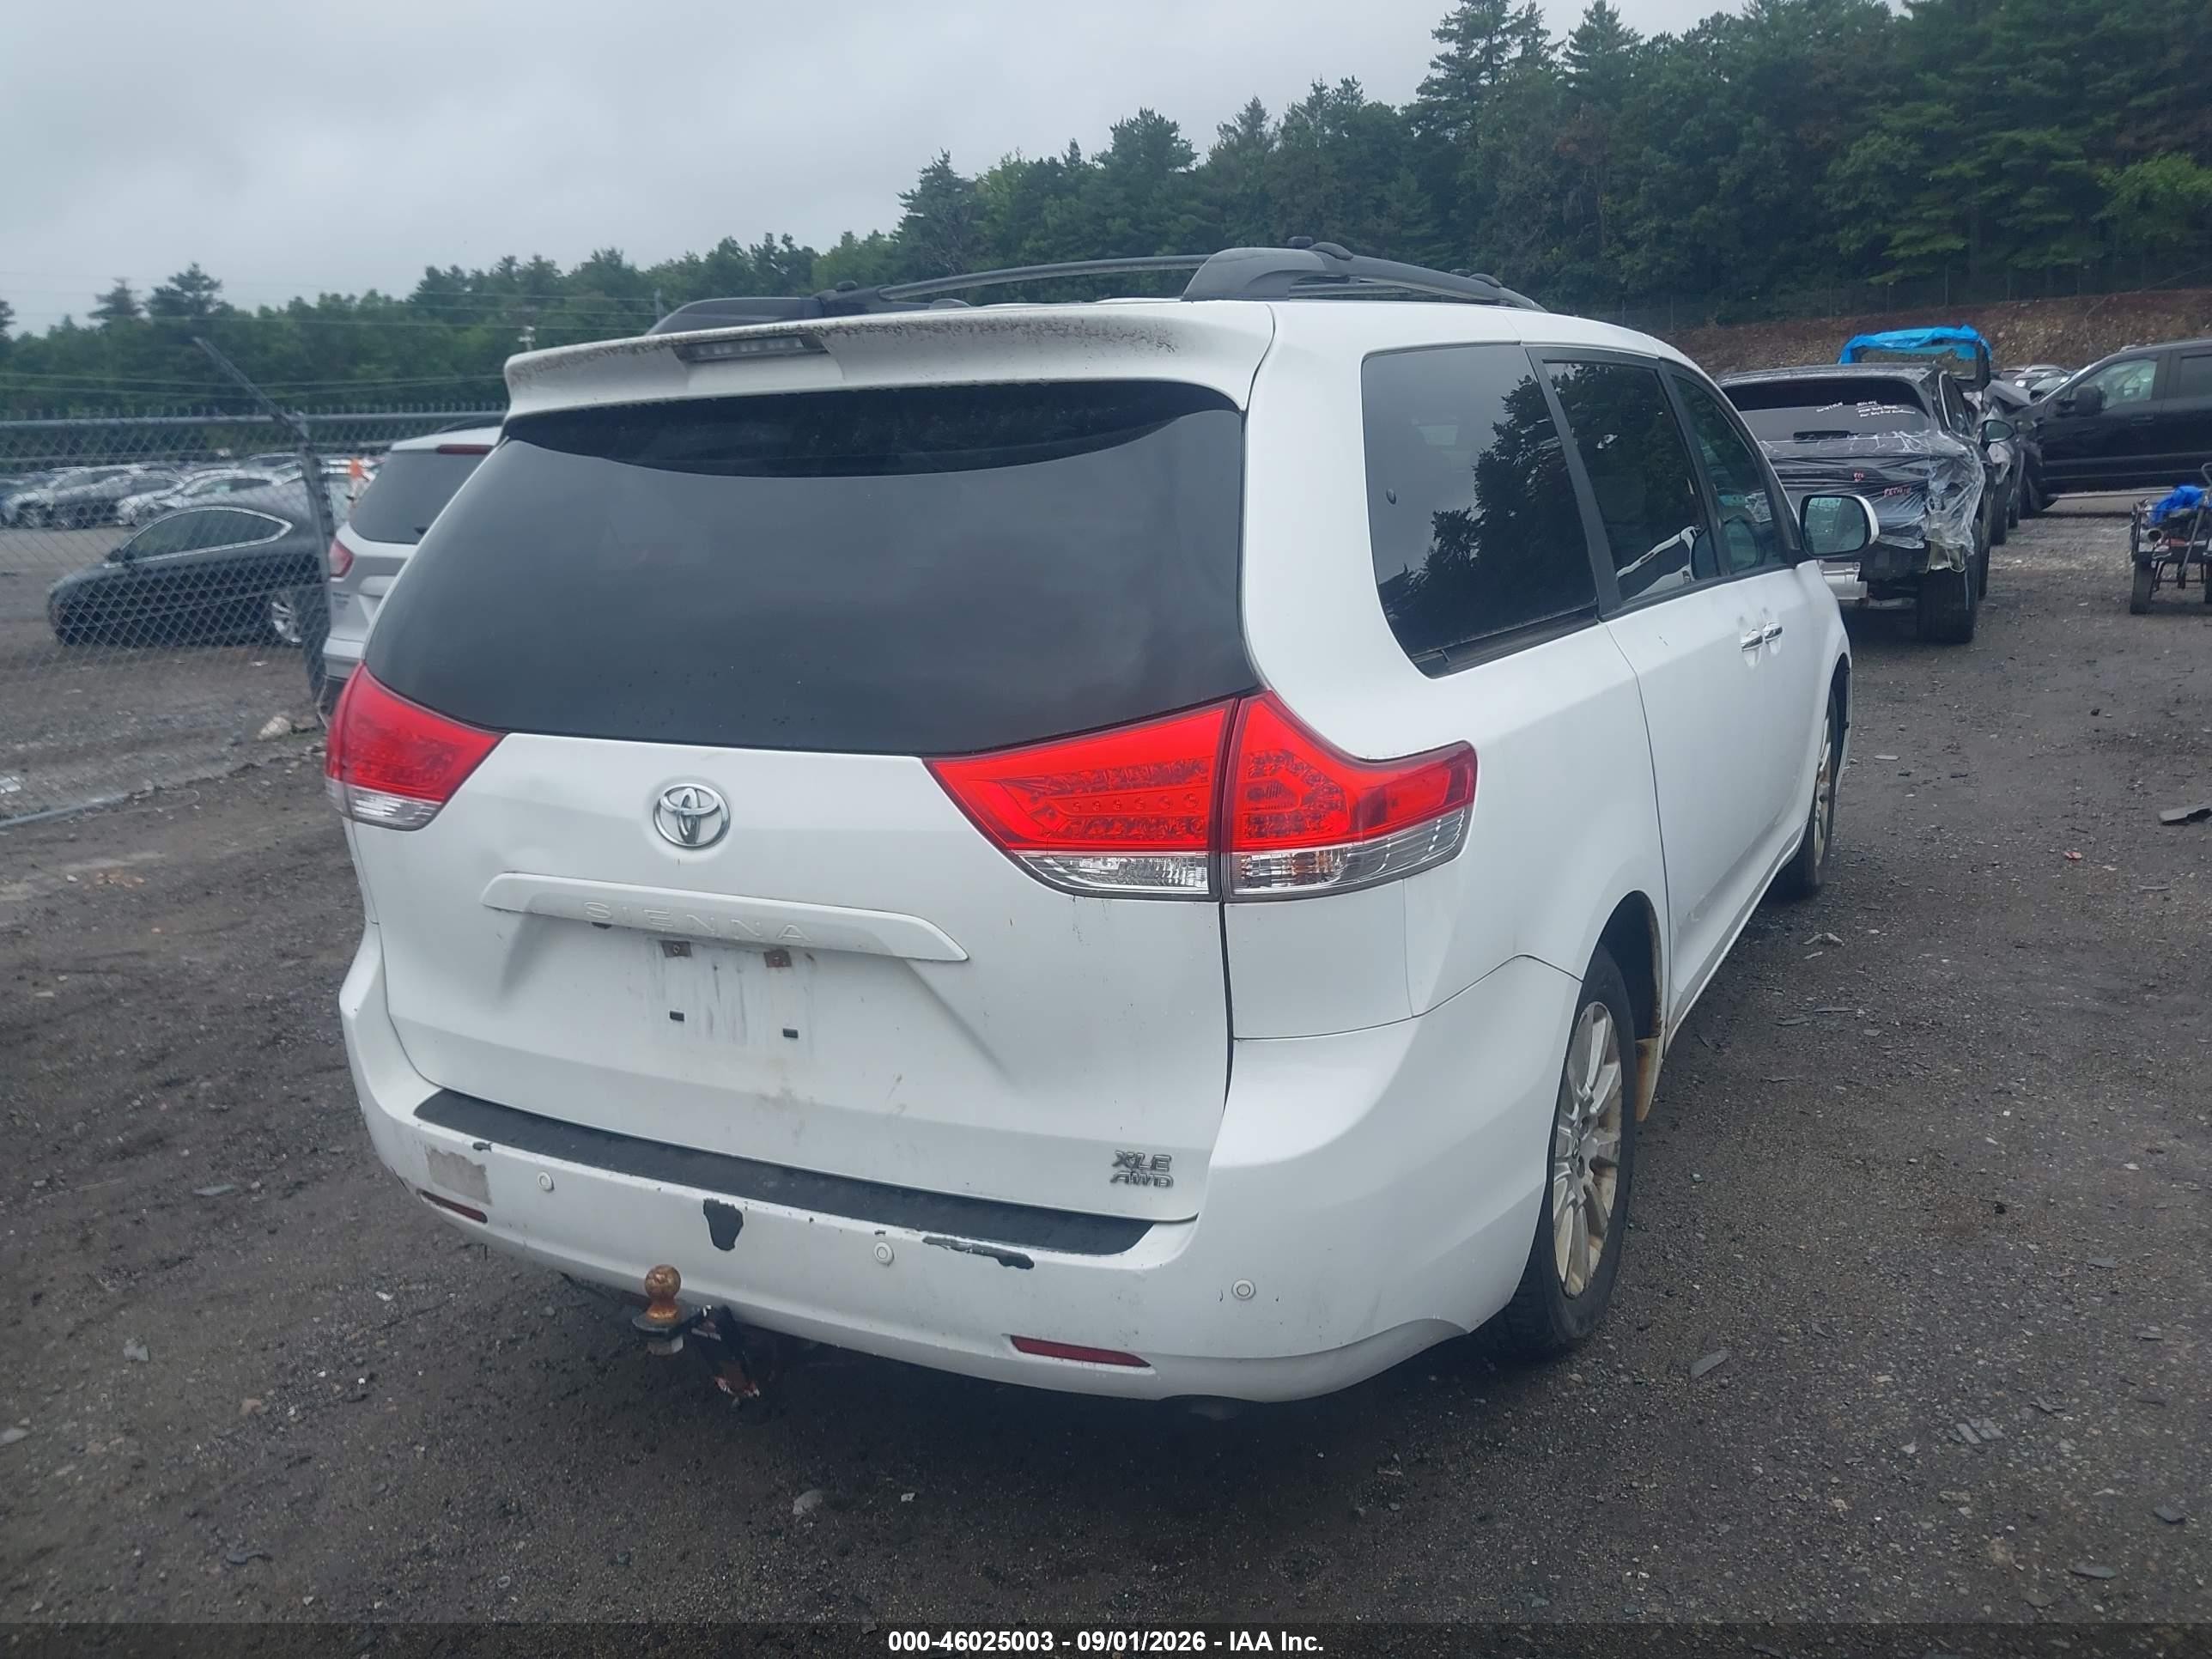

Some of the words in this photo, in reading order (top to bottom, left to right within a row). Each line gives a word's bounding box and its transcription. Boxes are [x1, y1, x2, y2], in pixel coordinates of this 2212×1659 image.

[584, 901, 812, 943] SIENNA
[1112, 1151, 1172, 1171] XLE
[1109, 1170, 1174, 1188] AWD
